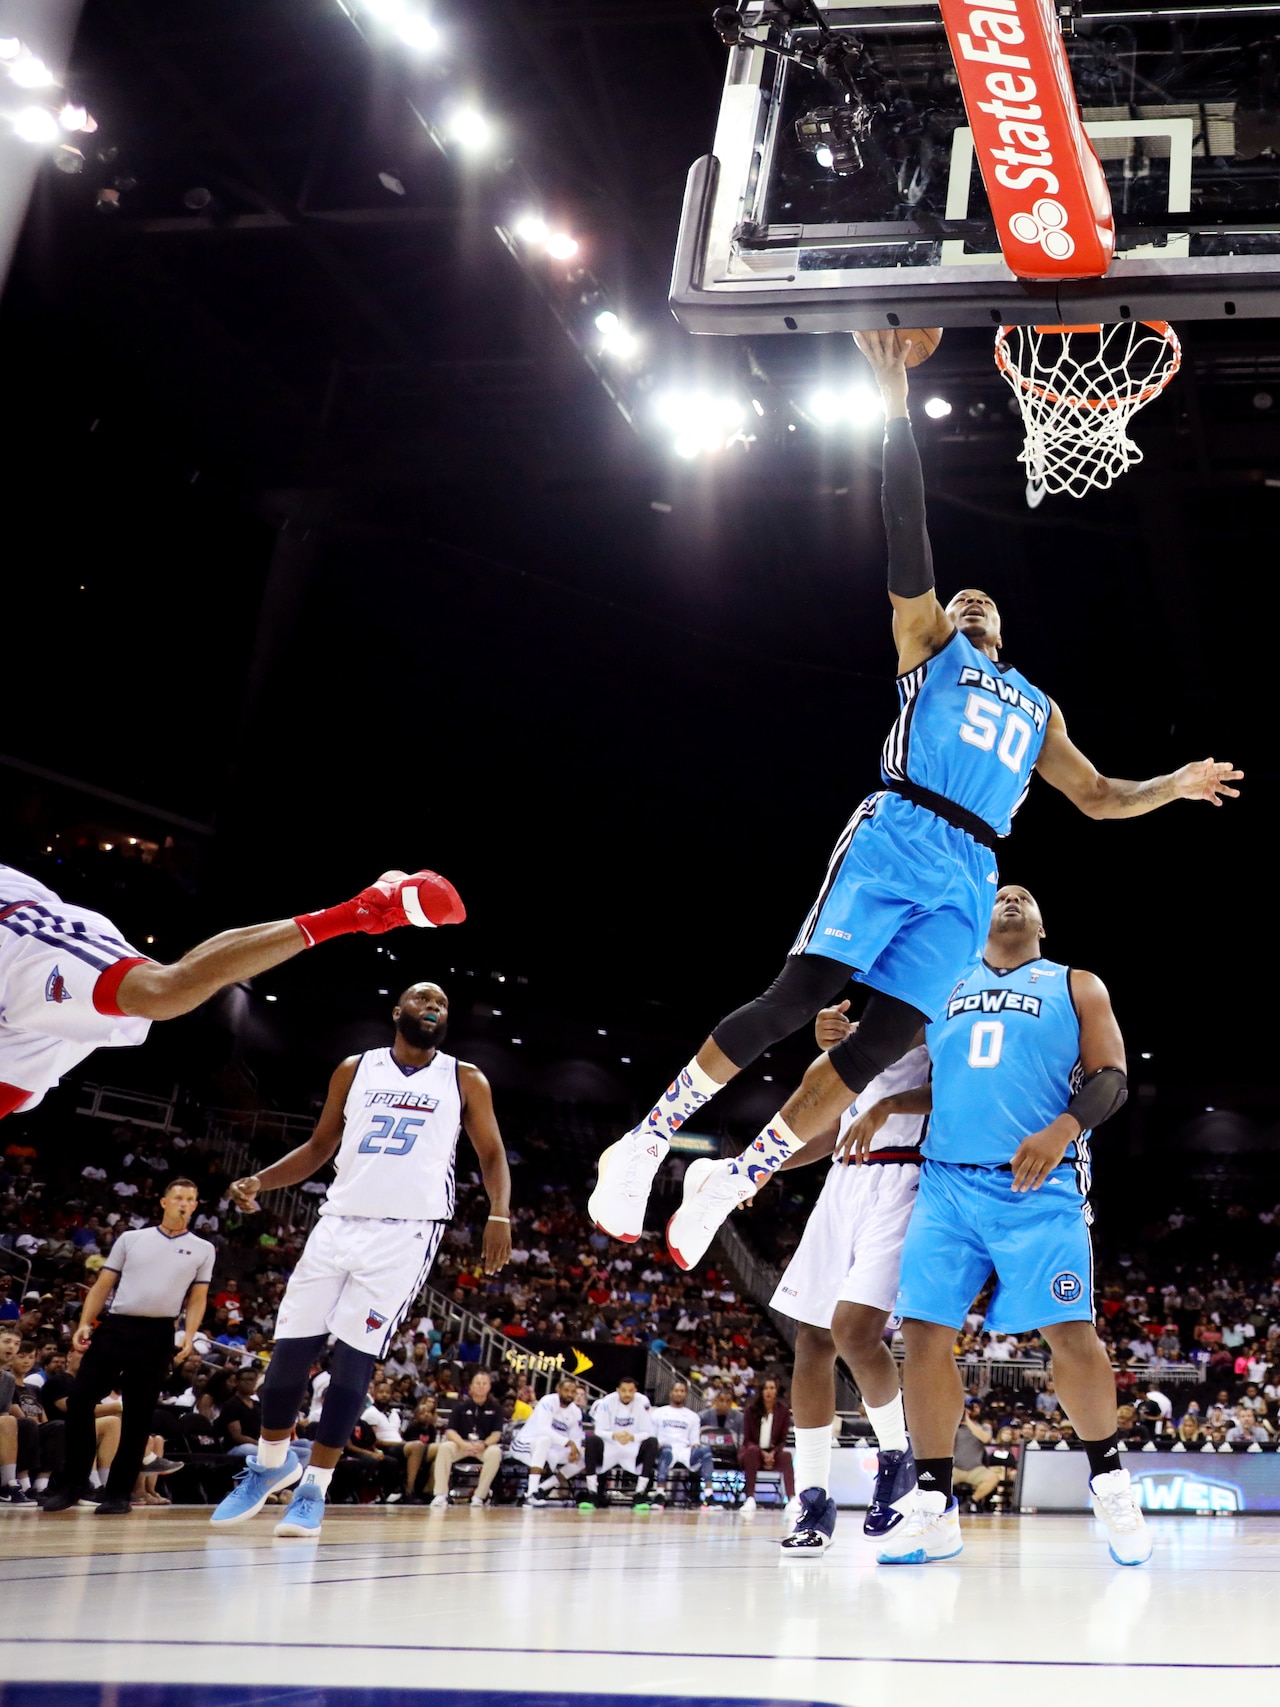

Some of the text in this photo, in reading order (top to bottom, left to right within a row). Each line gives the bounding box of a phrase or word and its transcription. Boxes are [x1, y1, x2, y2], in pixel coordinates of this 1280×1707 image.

[958, 665, 1045, 734] POWER
[958, 693, 1032, 773] 50
[824, 927, 853, 941] BIG3
[946, 989, 1043, 1020] POWER
[968, 1021, 1004, 1068] 0
[364, 1089, 441, 1113] Triplets
[358, 1115, 426, 1155] 25
[1060, 1280, 1076, 1296] P
[505, 1348, 566, 1374] Sprint
